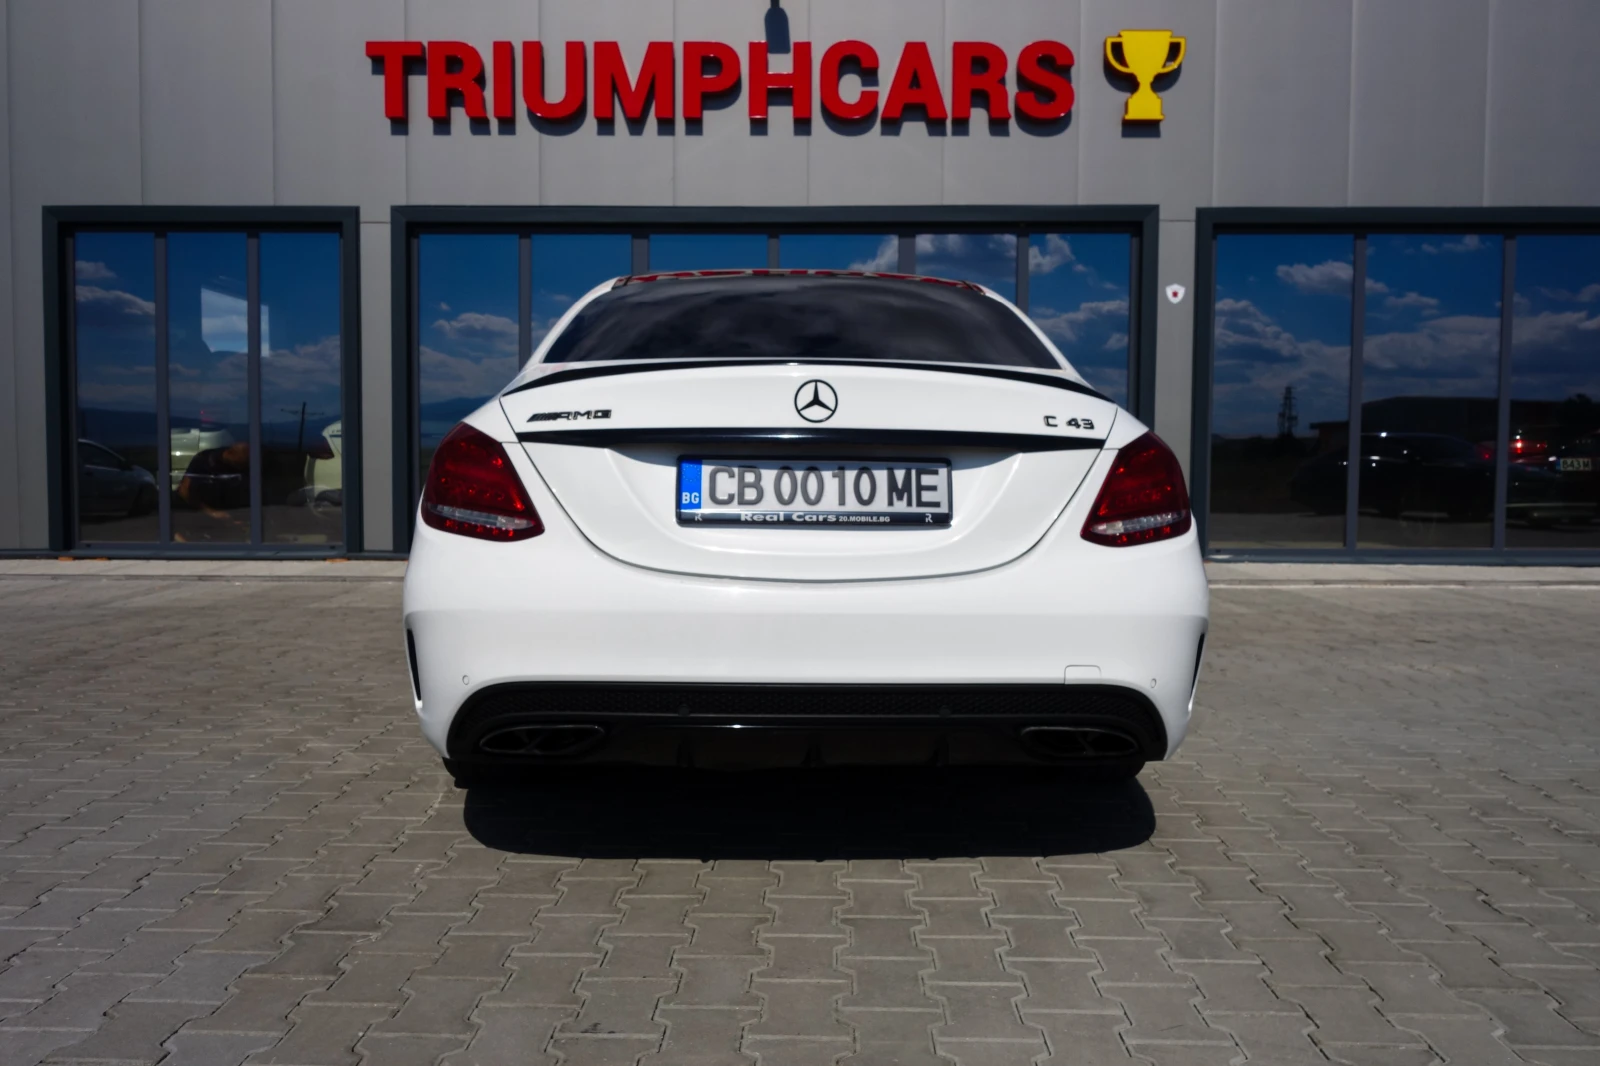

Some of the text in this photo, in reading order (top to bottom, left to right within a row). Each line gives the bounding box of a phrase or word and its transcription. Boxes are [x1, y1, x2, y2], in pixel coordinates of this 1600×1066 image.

[365, 41, 1075, 124] TRIUMPHCARS
[549, 409, 612, 421] AMG
[1043, 415, 1095, 430] C 43
[708, 465, 941, 508] CB 0010 ME
[682, 491, 700, 504] BG
[740, 512, 891, 523] Real Cars 20.MOBILE.BG
